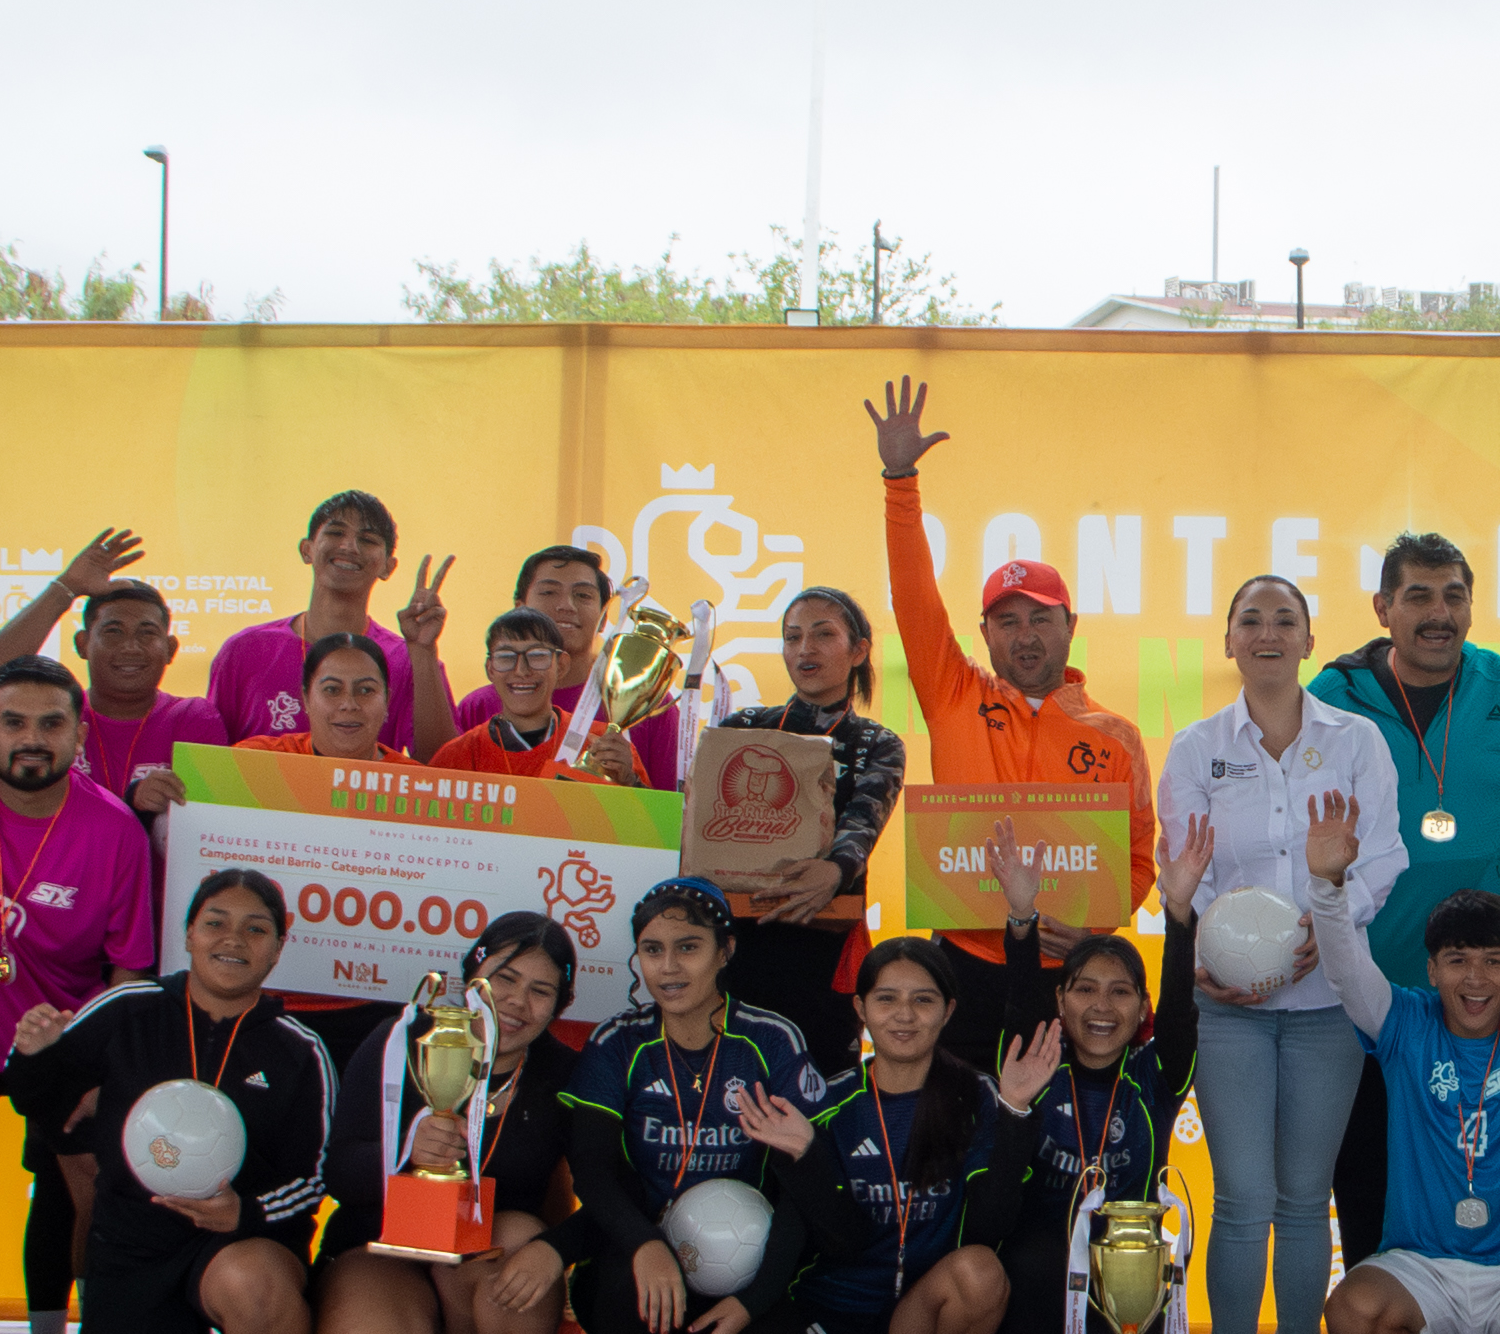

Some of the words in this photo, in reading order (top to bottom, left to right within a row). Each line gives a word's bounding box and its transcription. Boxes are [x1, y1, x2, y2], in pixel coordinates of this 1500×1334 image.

[185, 576, 273, 593] ESTATAL
[205, 593, 273, 614] FÍSICA
[333, 768, 409, 794] PONTE
[438, 778, 516, 804] NUEVO
[922, 795, 957, 803] PONTE
[704, 817, 798, 837] Bernal
[200, 847, 265, 864] Campeonas
[267, 855, 285, 866] del
[287, 856, 322, 869] Barrio
[331, 861, 388, 877] Categoría
[389, 867, 426, 881] Mayor
[939, 846, 985, 873] SAN
[26, 881, 78, 910] SIX
[1457, 1110, 1489, 1159] 4
[689, 1152, 741, 1171] BETTER
